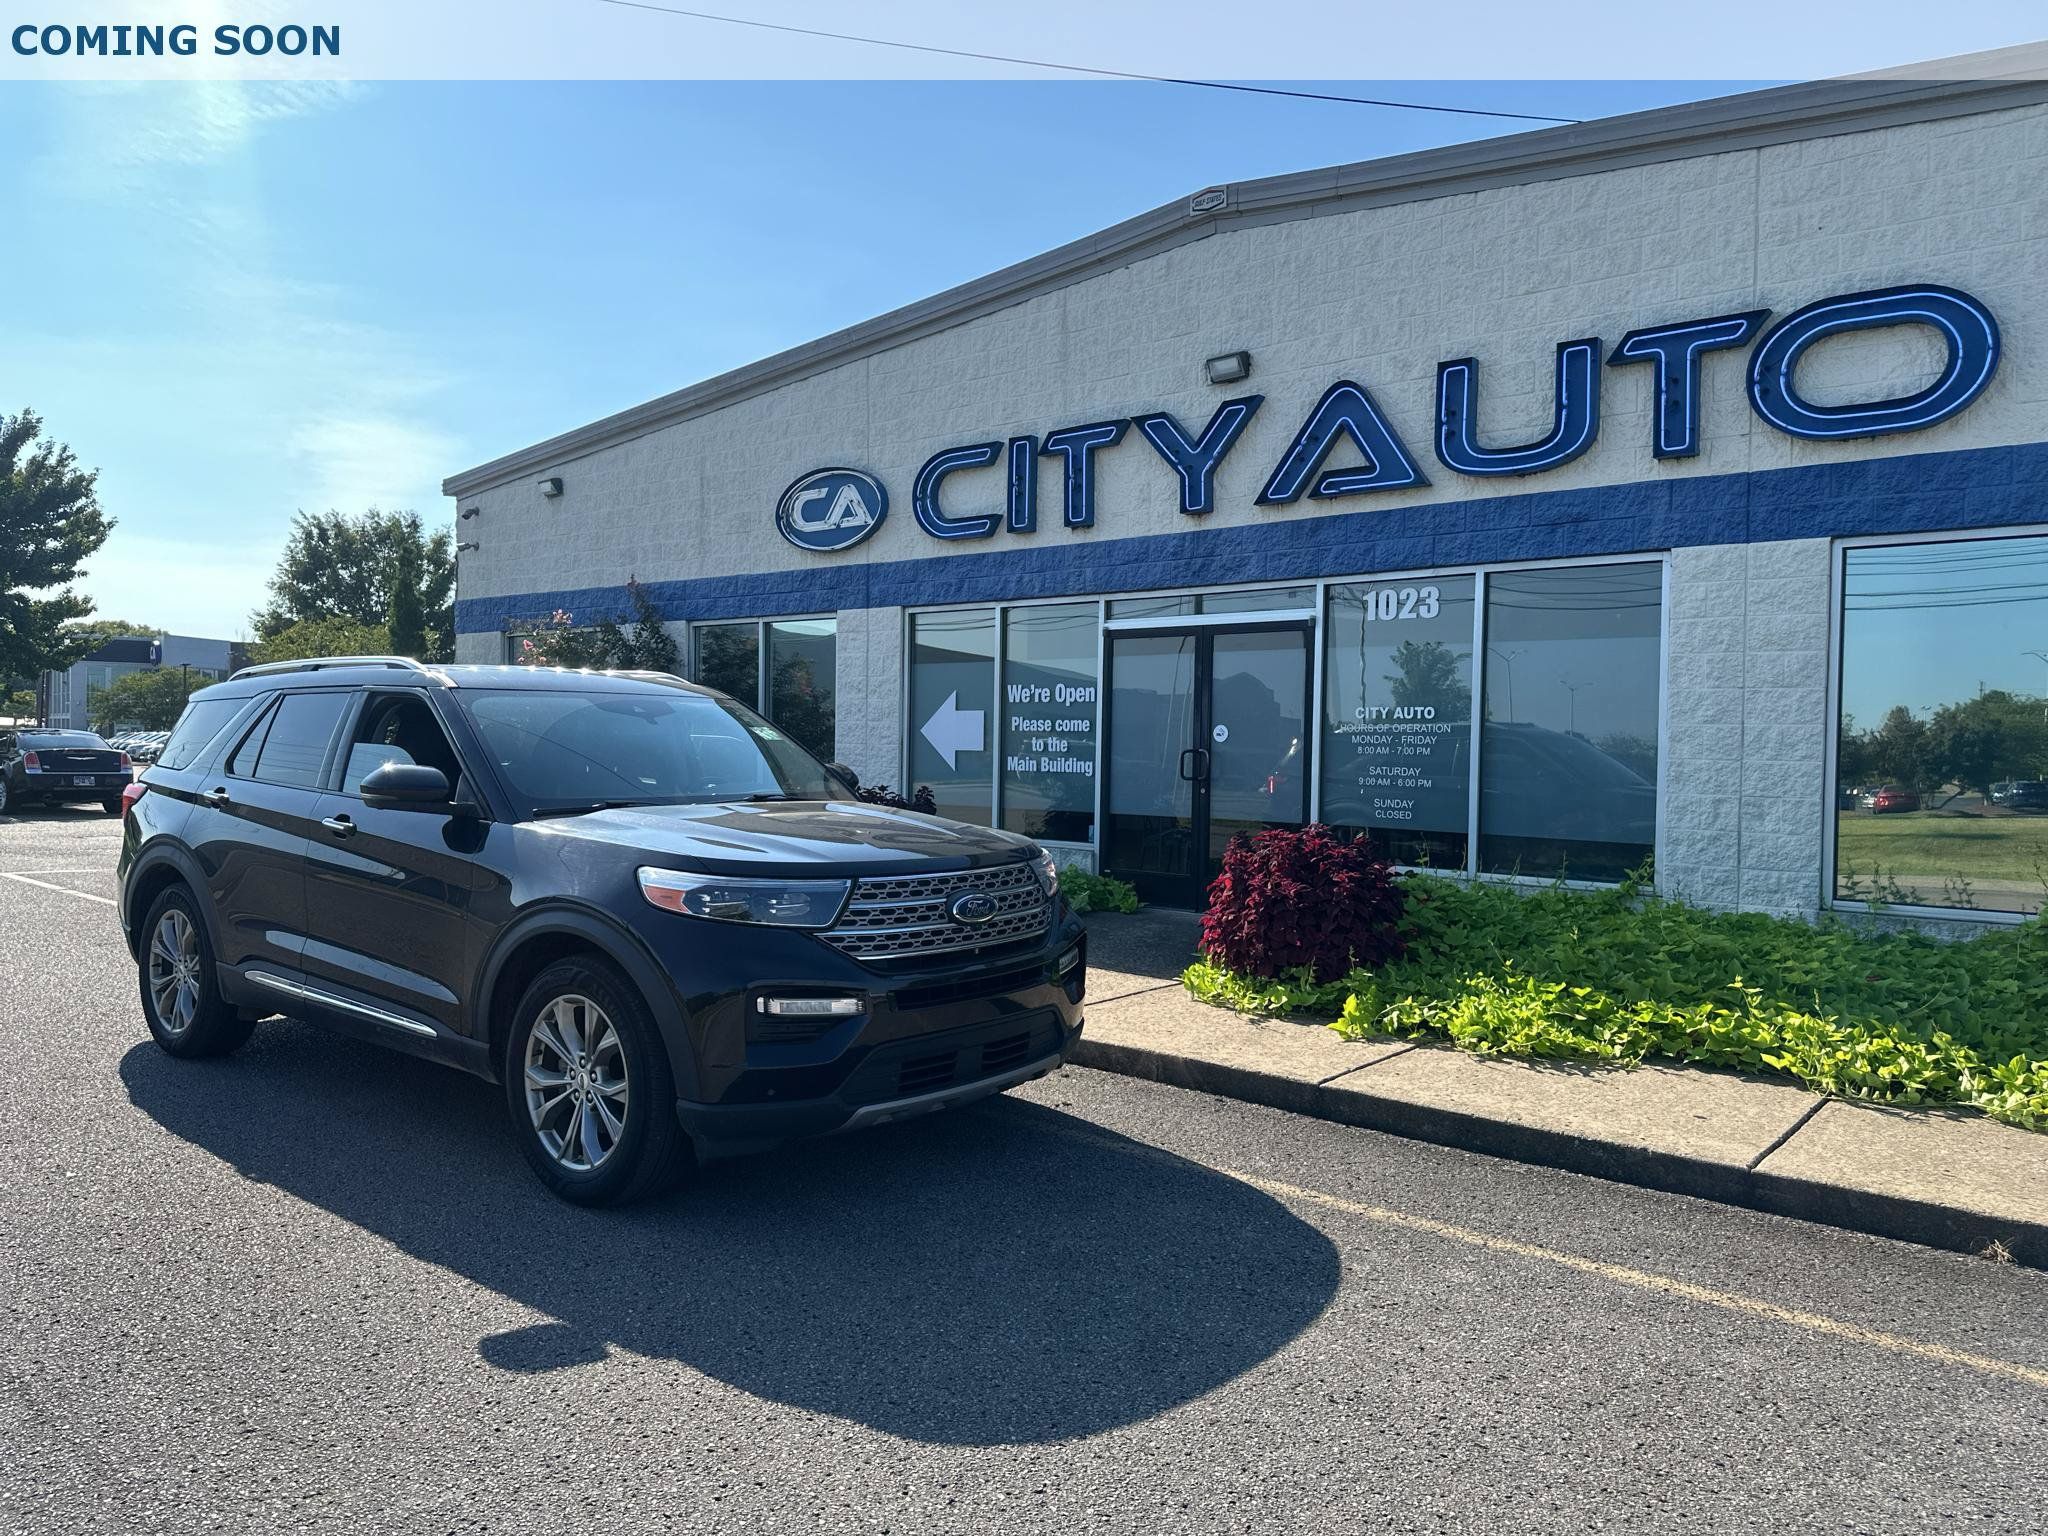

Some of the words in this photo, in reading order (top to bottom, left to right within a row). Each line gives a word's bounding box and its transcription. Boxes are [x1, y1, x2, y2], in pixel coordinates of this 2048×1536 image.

[912, 394, 1265, 540] CITY
[1253, 283, 2001, 506] AUTO
[792, 483, 872, 532] CA
[1363, 586, 1440, 622] 1023
[1007, 684, 1050, 703] We're
[1055, 683, 1095, 707] Open
[1355, 707, 1390, 719] CITY
[1393, 706, 1435, 719] AUTO
[1011, 716, 1051, 731] Please
[1055, 719, 1090, 731] come
[1340, 724, 1374, 733] HOURS
[1376, 724, 1390, 733] OF
[1392, 723, 1451, 733] OPERATION
[1032, 736, 1043, 752] to
[1047, 736, 1068, 752] the
[1352, 735, 1393, 744] MONDAY
[1401, 735, 1437, 745] FRIDAY
[1357, 746, 1375, 755] 8:00
[1376, 746, 1389, 755] AM
[1397, 746, 1414, 756] 7:00
[1416, 747, 1431, 756] PM
[1007, 756, 1037, 772] Main
[1040, 756, 1093, 777] Building
[1369, 766, 1421, 776] SATURDAY
[1358, 777, 1376, 786] 9:00
[1377, 778, 1390, 786] AM
[1397, 778, 1416, 787] 6:00
[1417, 779, 1432, 788] PM
[1374, 798, 1415, 808] SUNDAY
[1375, 809, 1412, 820] CLOSED
[967, 900, 990, 917] Ford
